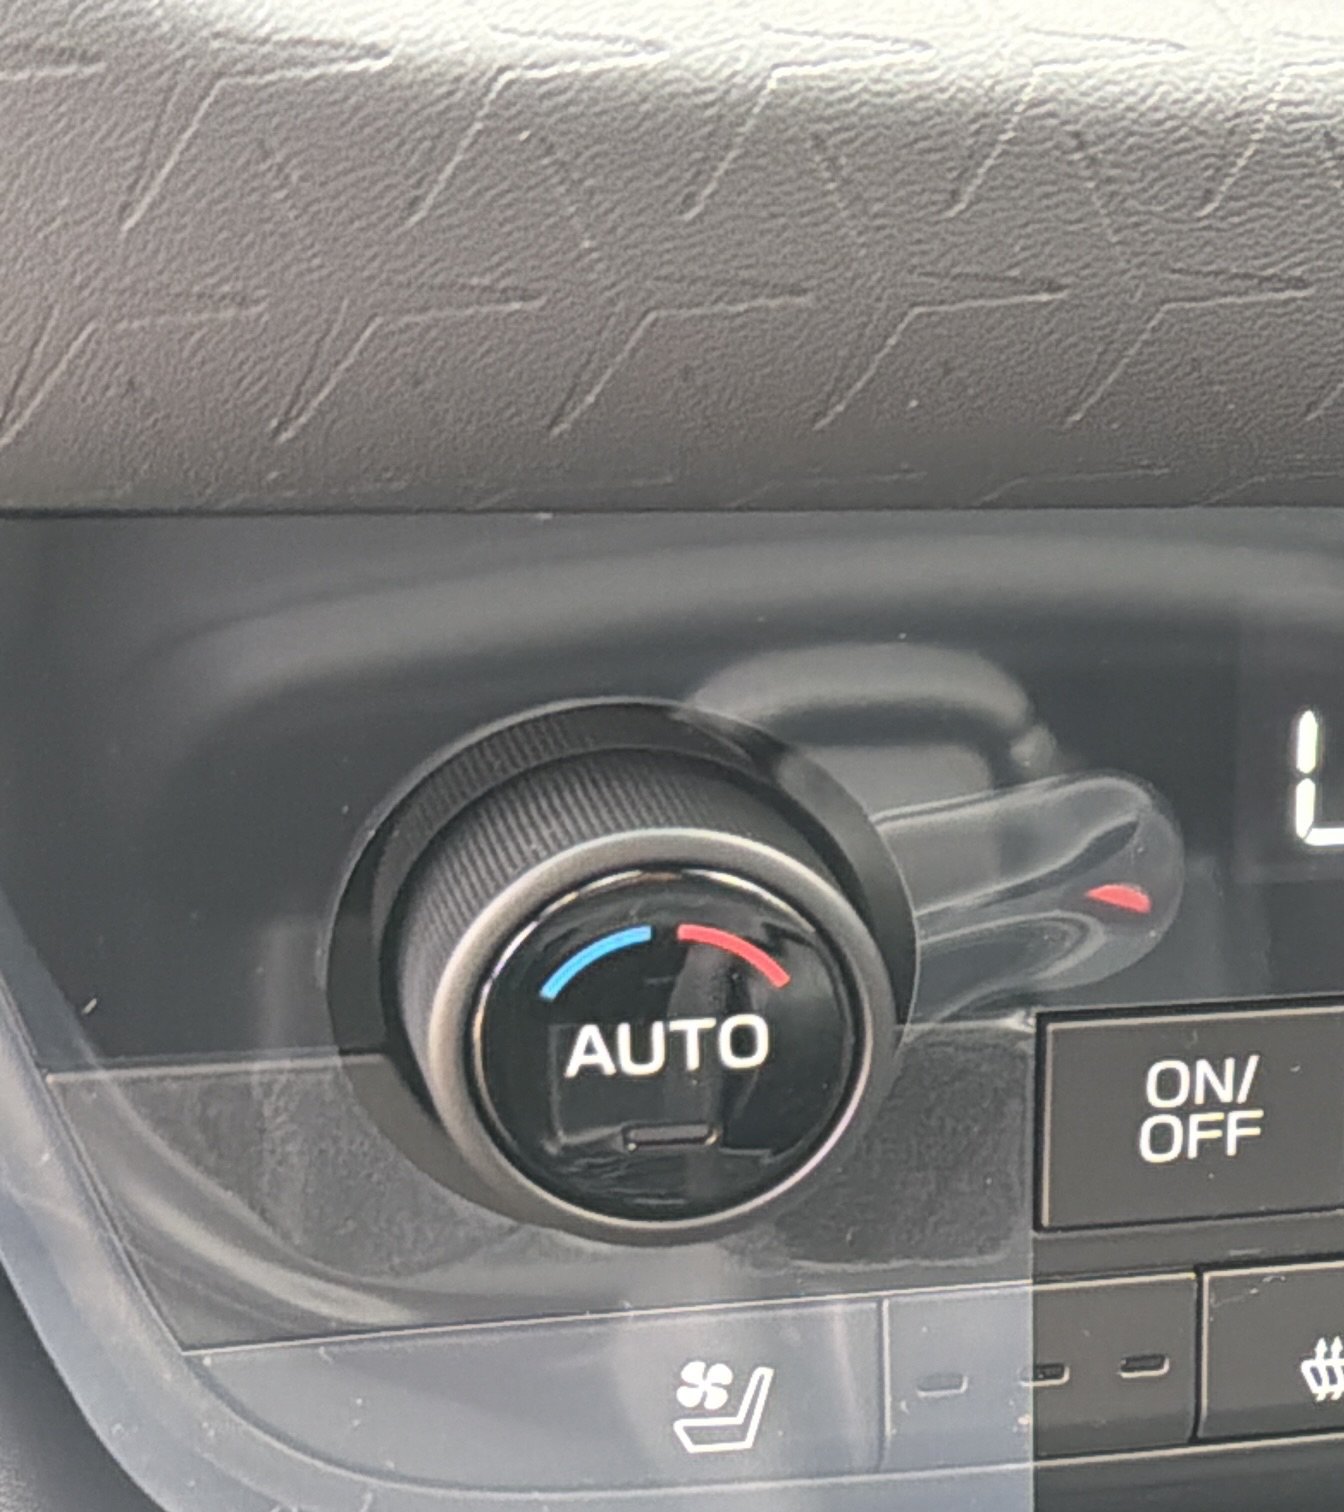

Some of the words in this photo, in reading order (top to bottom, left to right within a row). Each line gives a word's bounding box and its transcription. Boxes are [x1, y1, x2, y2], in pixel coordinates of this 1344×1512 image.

[564, 1012, 770, 1079] AUTO
[1145, 1054, 1260, 1110] ON/
[1138, 1109, 1265, 1164] OFF
